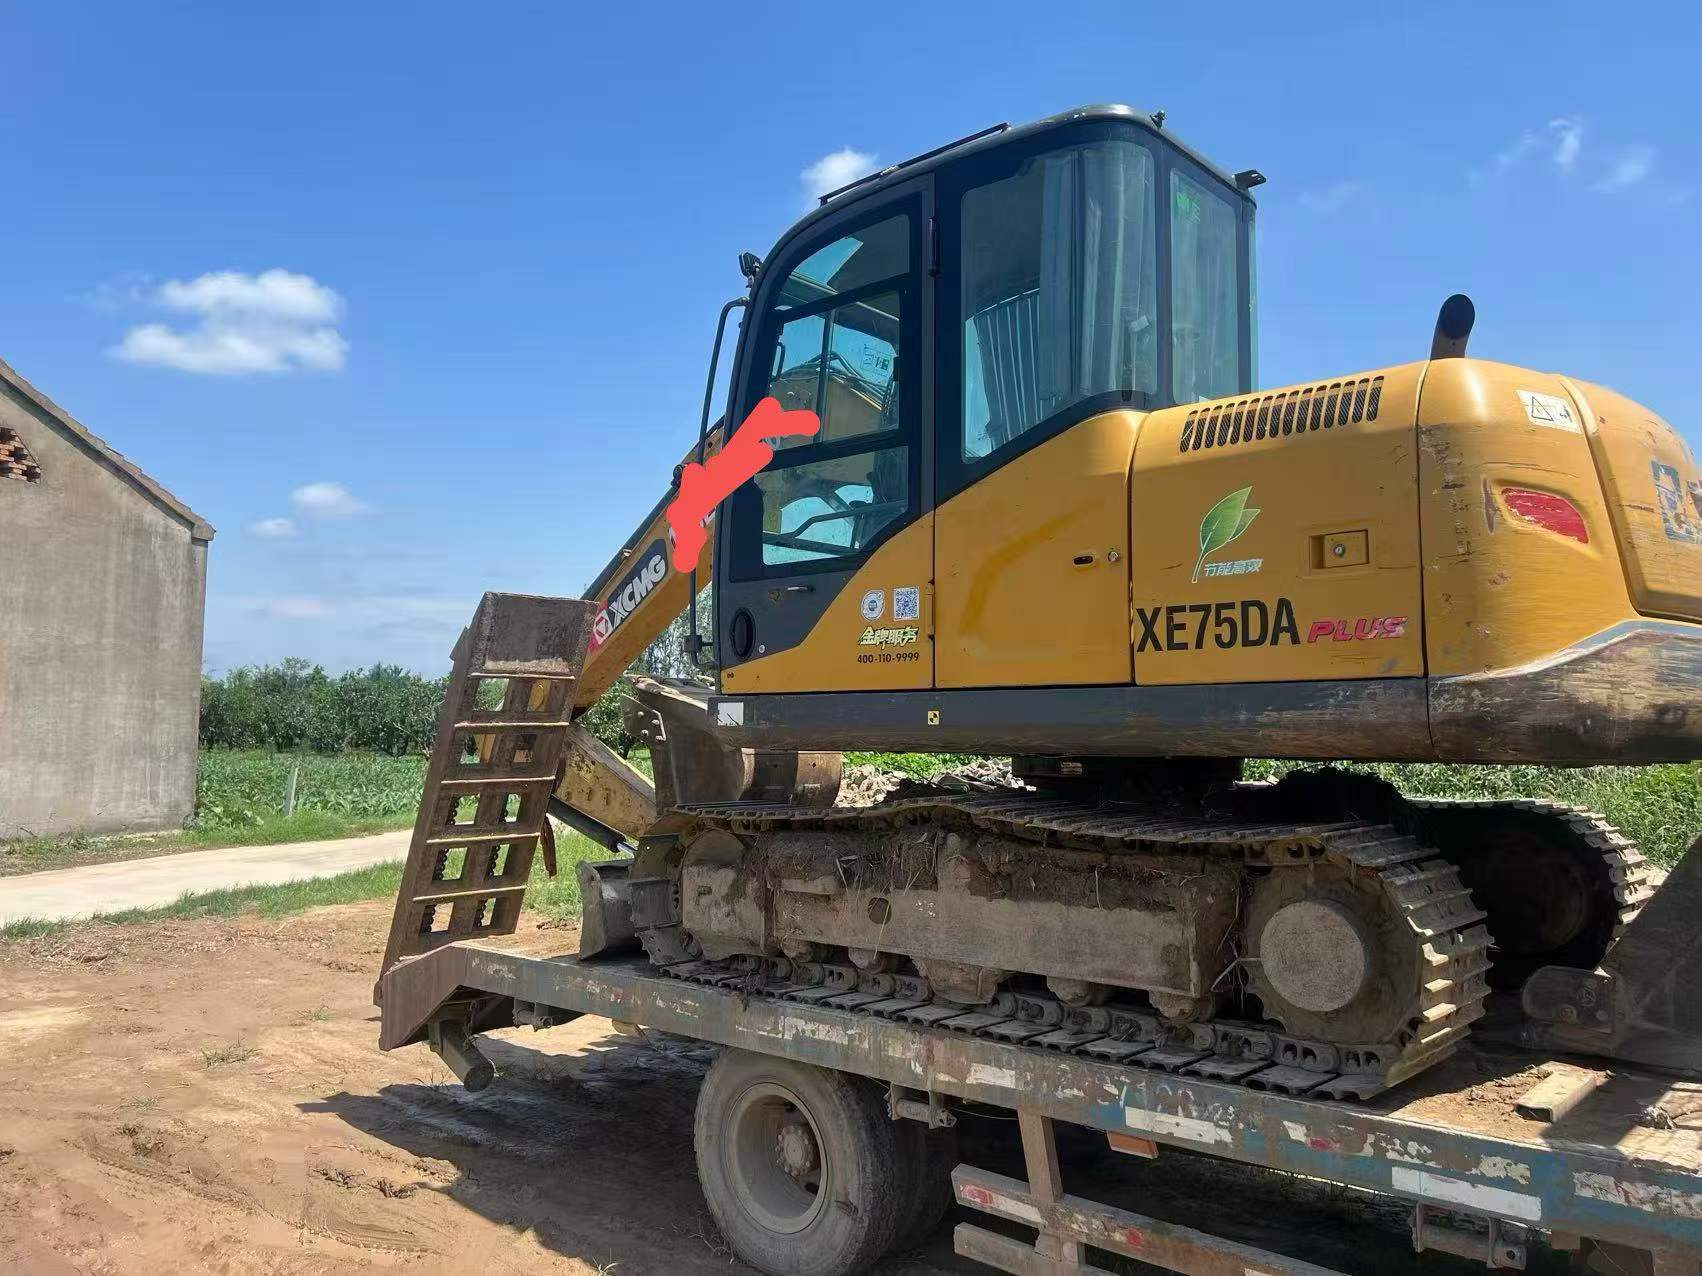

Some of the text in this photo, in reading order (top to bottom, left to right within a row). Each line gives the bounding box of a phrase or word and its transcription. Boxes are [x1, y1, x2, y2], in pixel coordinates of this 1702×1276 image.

[1204, 559, 1263, 576] 节能高效
[608, 554, 666, 629] XCMG
[1135, 597, 1408, 652] XE75DA PLUS
[859, 626, 919, 650] 金牌服务
[857, 652, 920, 664] 400-110-9999
